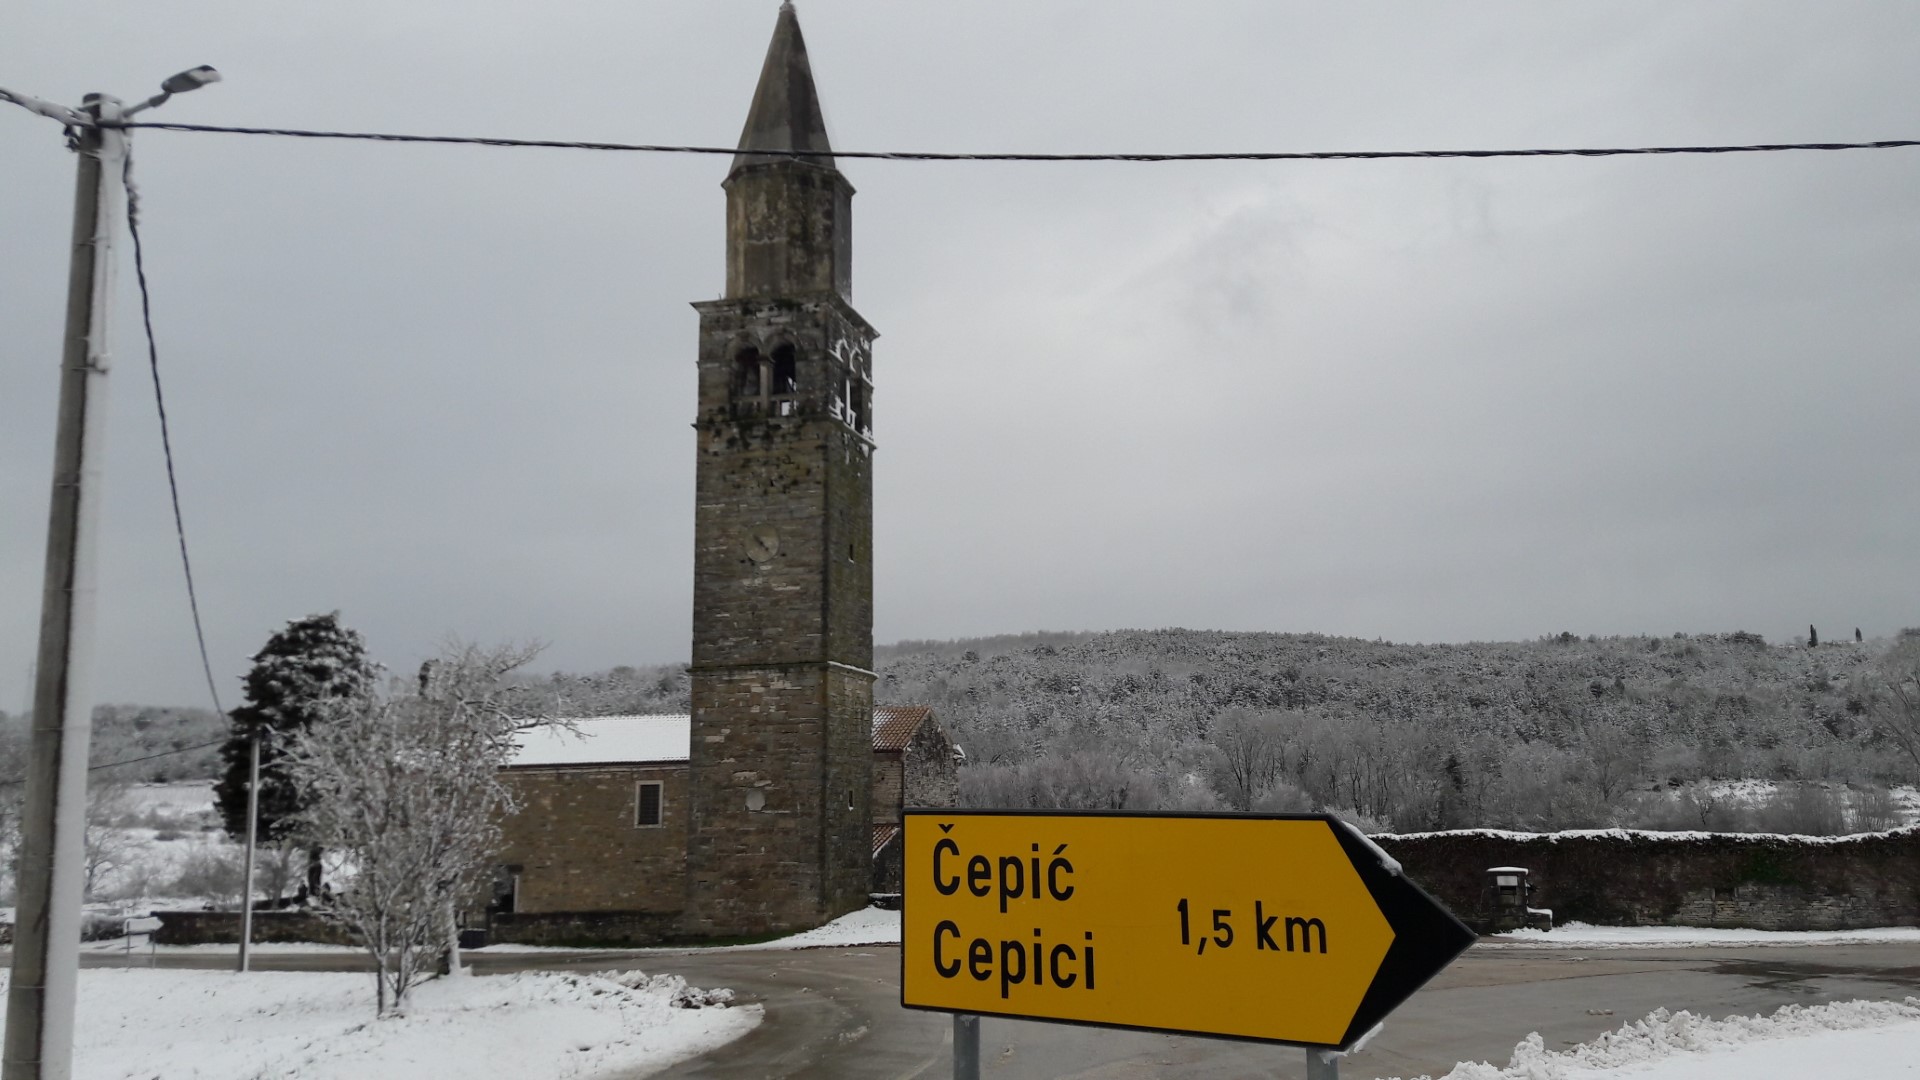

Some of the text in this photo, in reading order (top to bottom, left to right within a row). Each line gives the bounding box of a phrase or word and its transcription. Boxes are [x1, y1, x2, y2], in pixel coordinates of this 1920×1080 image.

[932, 823, 1075, 914] Čepić
[933, 919, 1095, 1000] Cepici
[1176, 897, 1328, 956] 1,5 km
